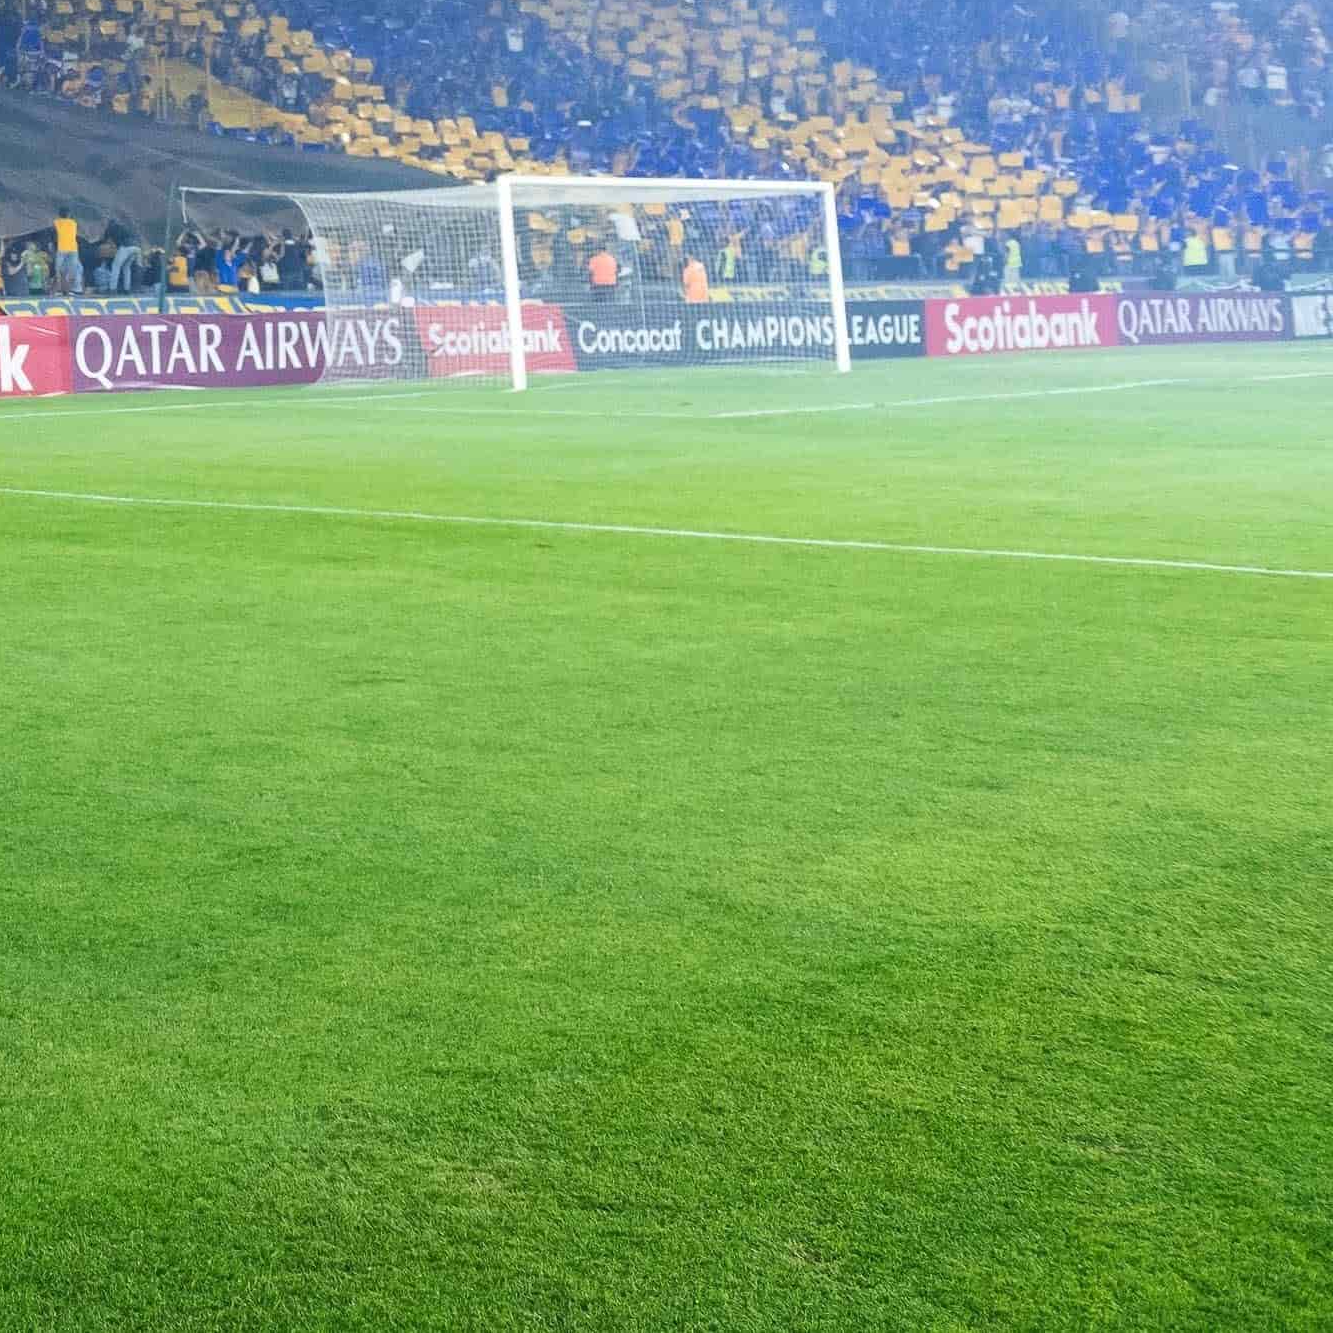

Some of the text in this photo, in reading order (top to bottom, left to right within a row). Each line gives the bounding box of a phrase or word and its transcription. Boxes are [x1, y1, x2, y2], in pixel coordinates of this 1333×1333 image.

[577, 321, 683, 353] Concacaf
[696, 315, 833, 350] CHAMPIONS
[944, 298, 1102, 354] Scotiabank
[1117, 299, 1193, 344] QATAR
[1197, 298, 1283, 333] AIRWAYS
[74, 318, 403, 388] QATAR AIRWAYS
